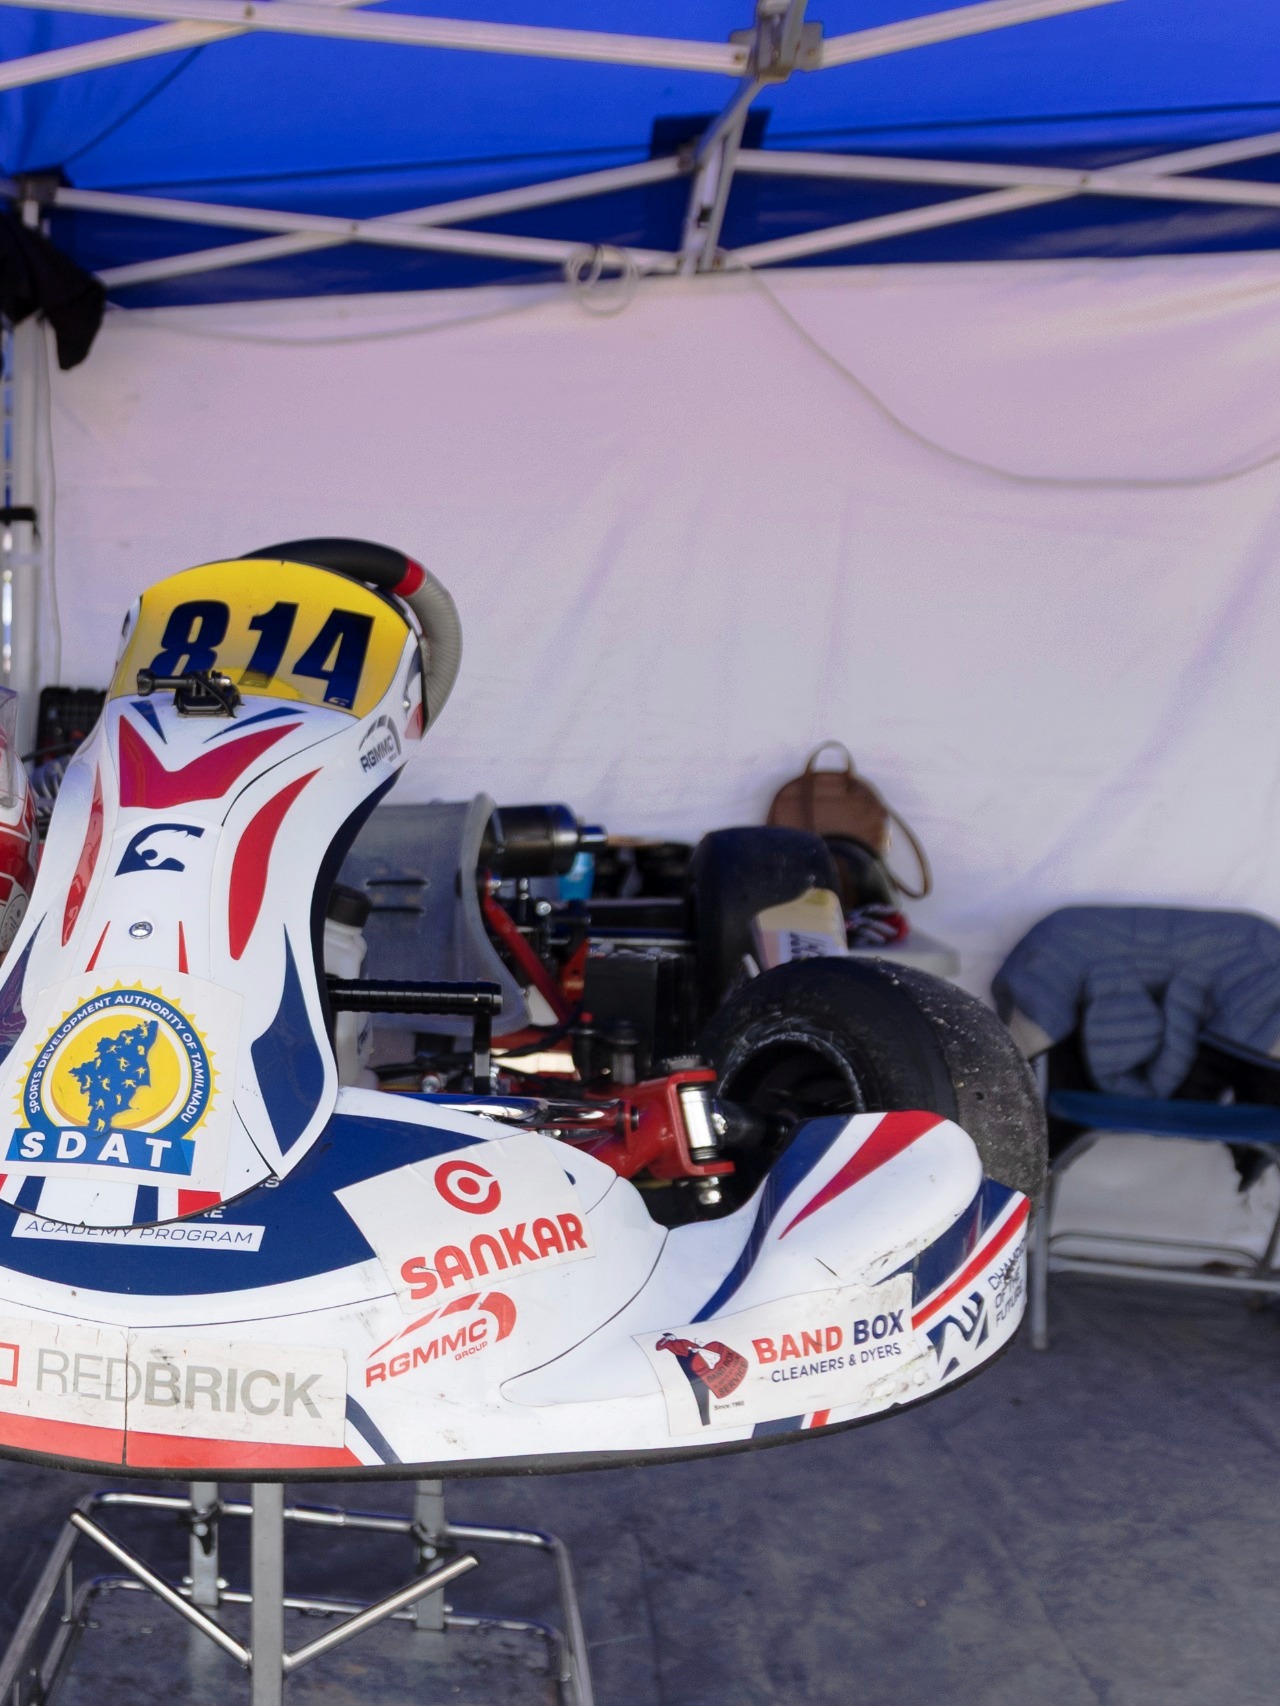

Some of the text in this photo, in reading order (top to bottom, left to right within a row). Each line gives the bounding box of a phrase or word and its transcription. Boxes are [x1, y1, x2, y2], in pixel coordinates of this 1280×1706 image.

[149, 600, 375, 710] 814
[360, 735, 394, 772] RGMMC
[29, 995, 205, 1123] SPORTS DEVELOPMENT AUTHORITY OF TAMILNADU
[25, 1220, 253, 1244] ACADEMY PROGRAM
[400, 1212, 588, 1300] SANKAR
[366, 1318, 488, 1388] RGMMC
[455, 1340, 489, 1361] GROUP
[751, 1309, 904, 1364] BAND BOX
[771, 1342, 902, 1383] CLEANERS & DYERS
[35, 1348, 323, 1419] REDBRICK
[719, 1361, 748, 1396] SERVICE
